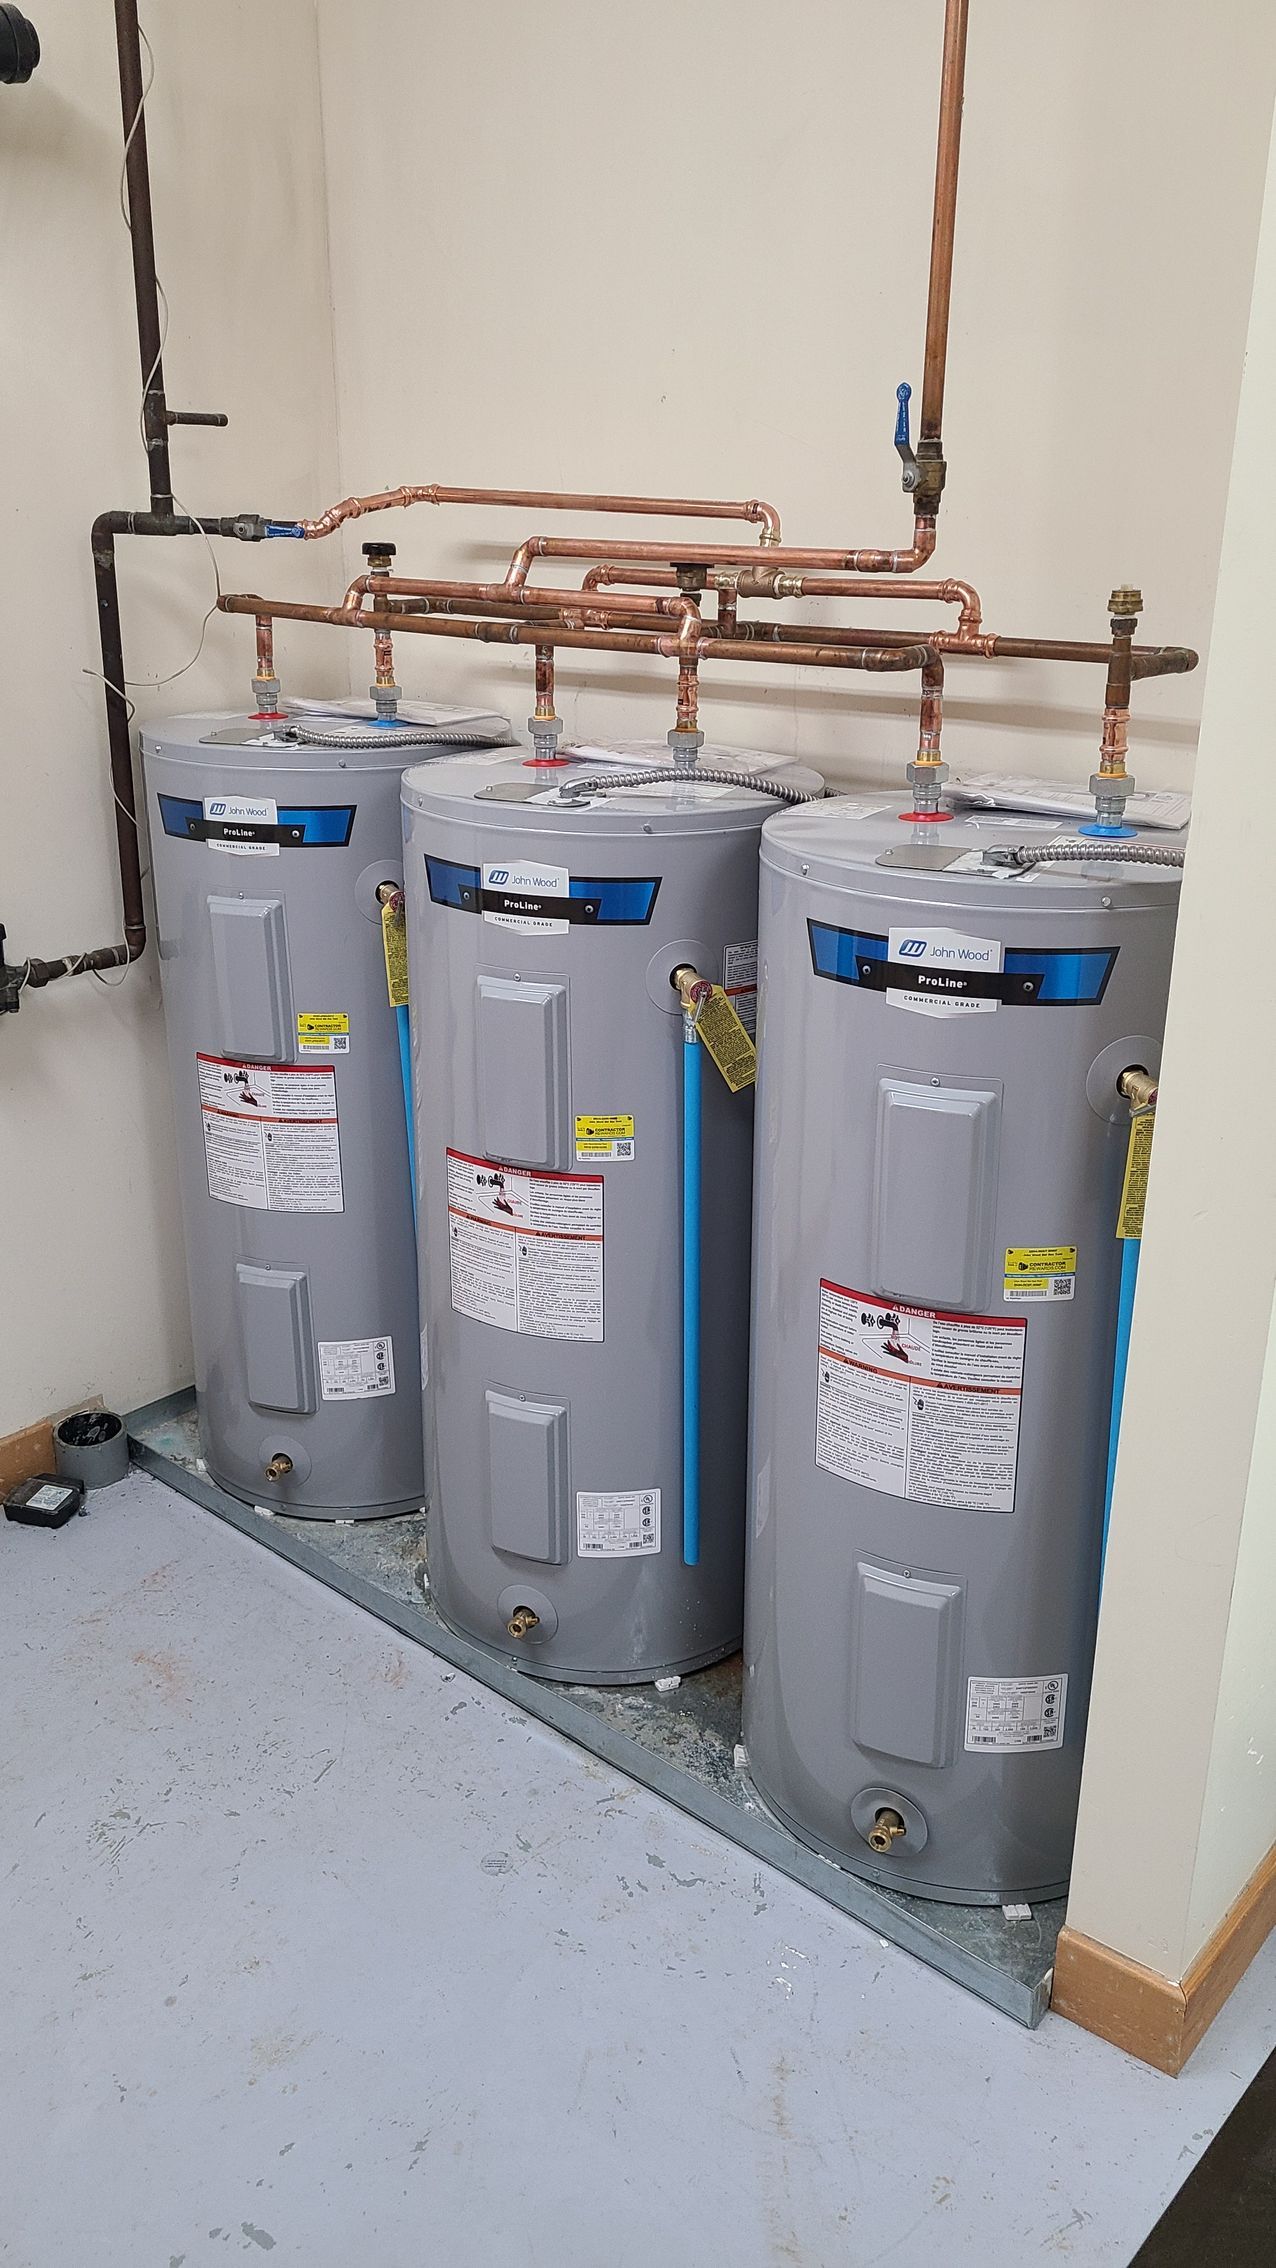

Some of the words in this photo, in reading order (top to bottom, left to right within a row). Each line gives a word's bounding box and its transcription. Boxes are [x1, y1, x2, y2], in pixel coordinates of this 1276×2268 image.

[228, 807, 245, 815] John
[246, 808, 267, 816] Wood
[512, 876, 531, 886] John
[532, 877, 557, 887] Wood
[494, 916, 530, 925] COMMERCIAL
[930, 946, 956, 958] John
[958, 948, 989, 961] Wood
[903, 995, 952, 1006] COMMERCIAL
[503, 1166, 532, 1177] DANGER
[899, 1305, 936, 1319] DANGER
[849, 1360, 878, 1374] WARNING
[943, 1384, 1001, 1395] AVERTISSEMENT
